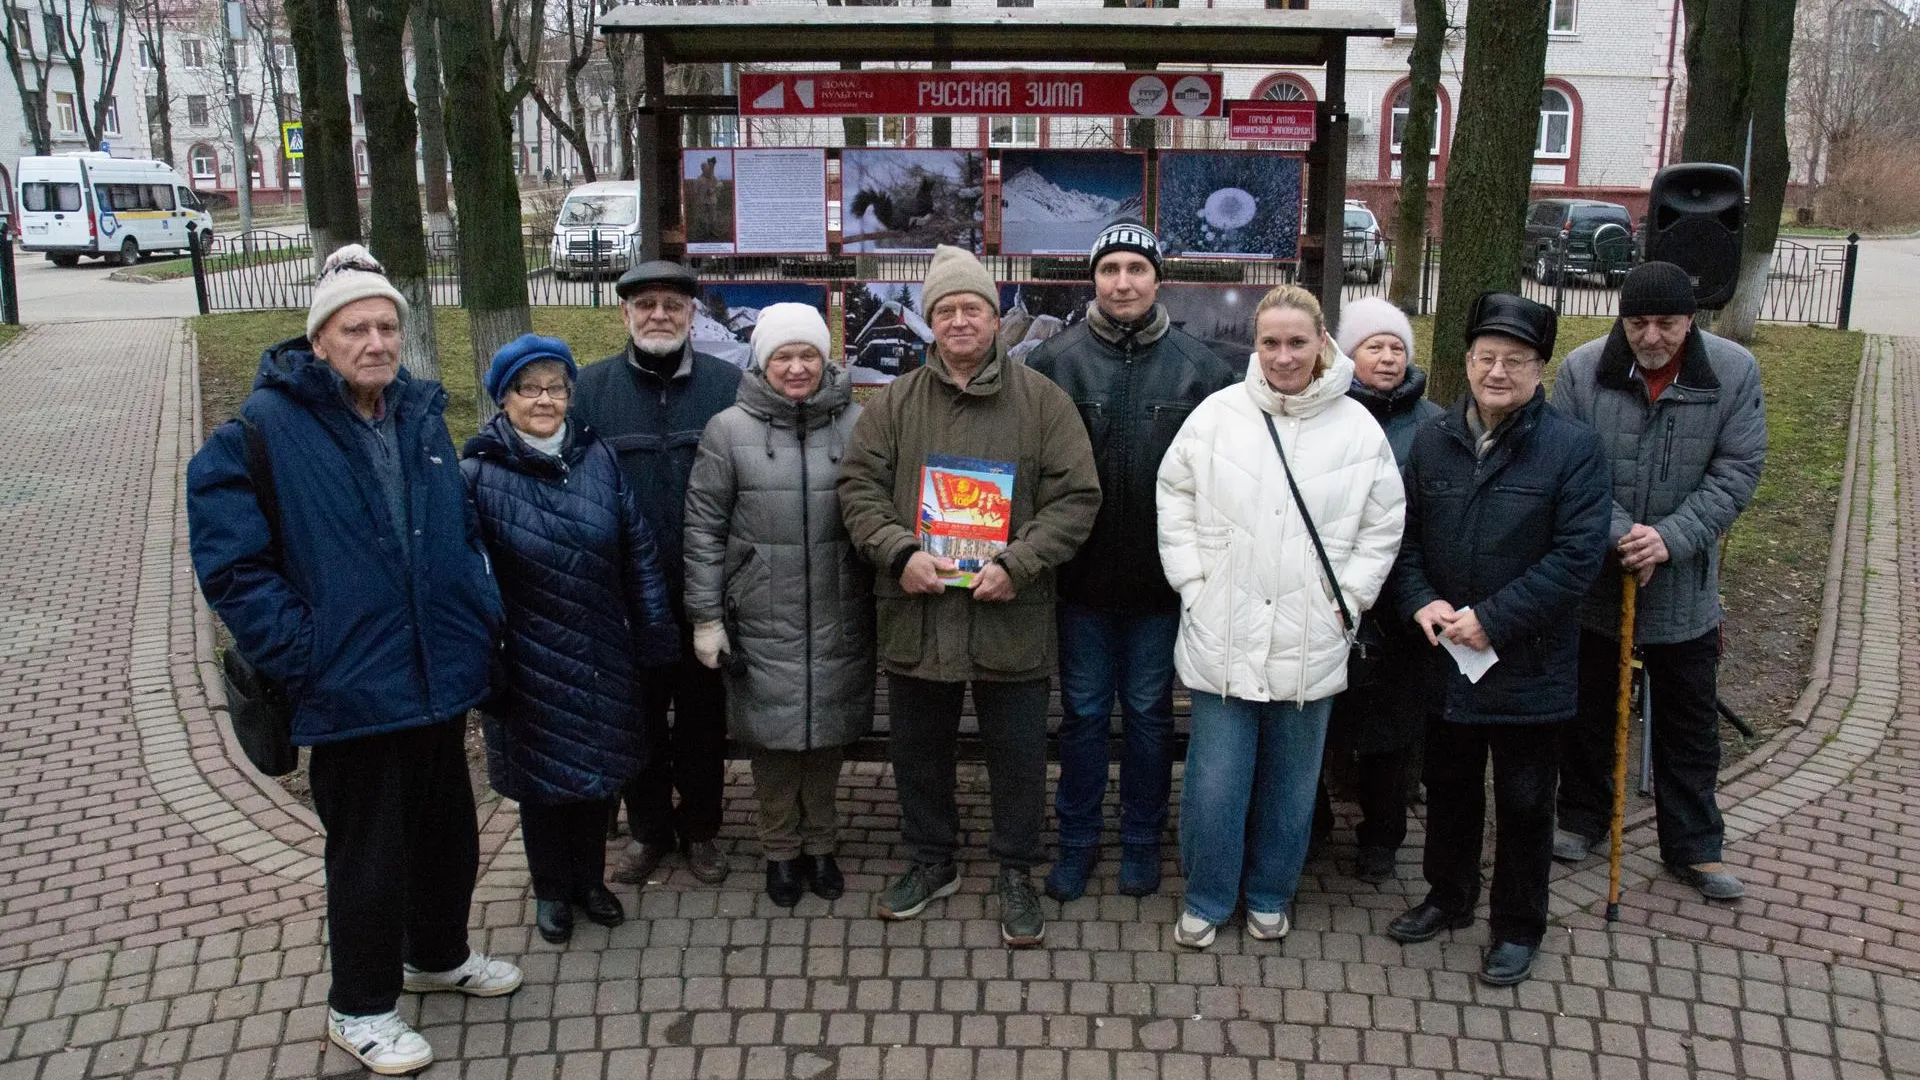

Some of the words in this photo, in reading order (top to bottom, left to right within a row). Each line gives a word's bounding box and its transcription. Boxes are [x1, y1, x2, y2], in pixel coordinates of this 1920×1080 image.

[821, 81, 856, 89] ДОМА
[821, 90, 874, 99] КУЛЬТУРЫ
[918, 81, 1011, 107] РУССКАЯ
[1025, 81, 1083, 107] ЗИМА
[1248, 115, 1273, 124] ГОРНЫЙ
[1276, 115, 1296, 124] АЛТАЙ
